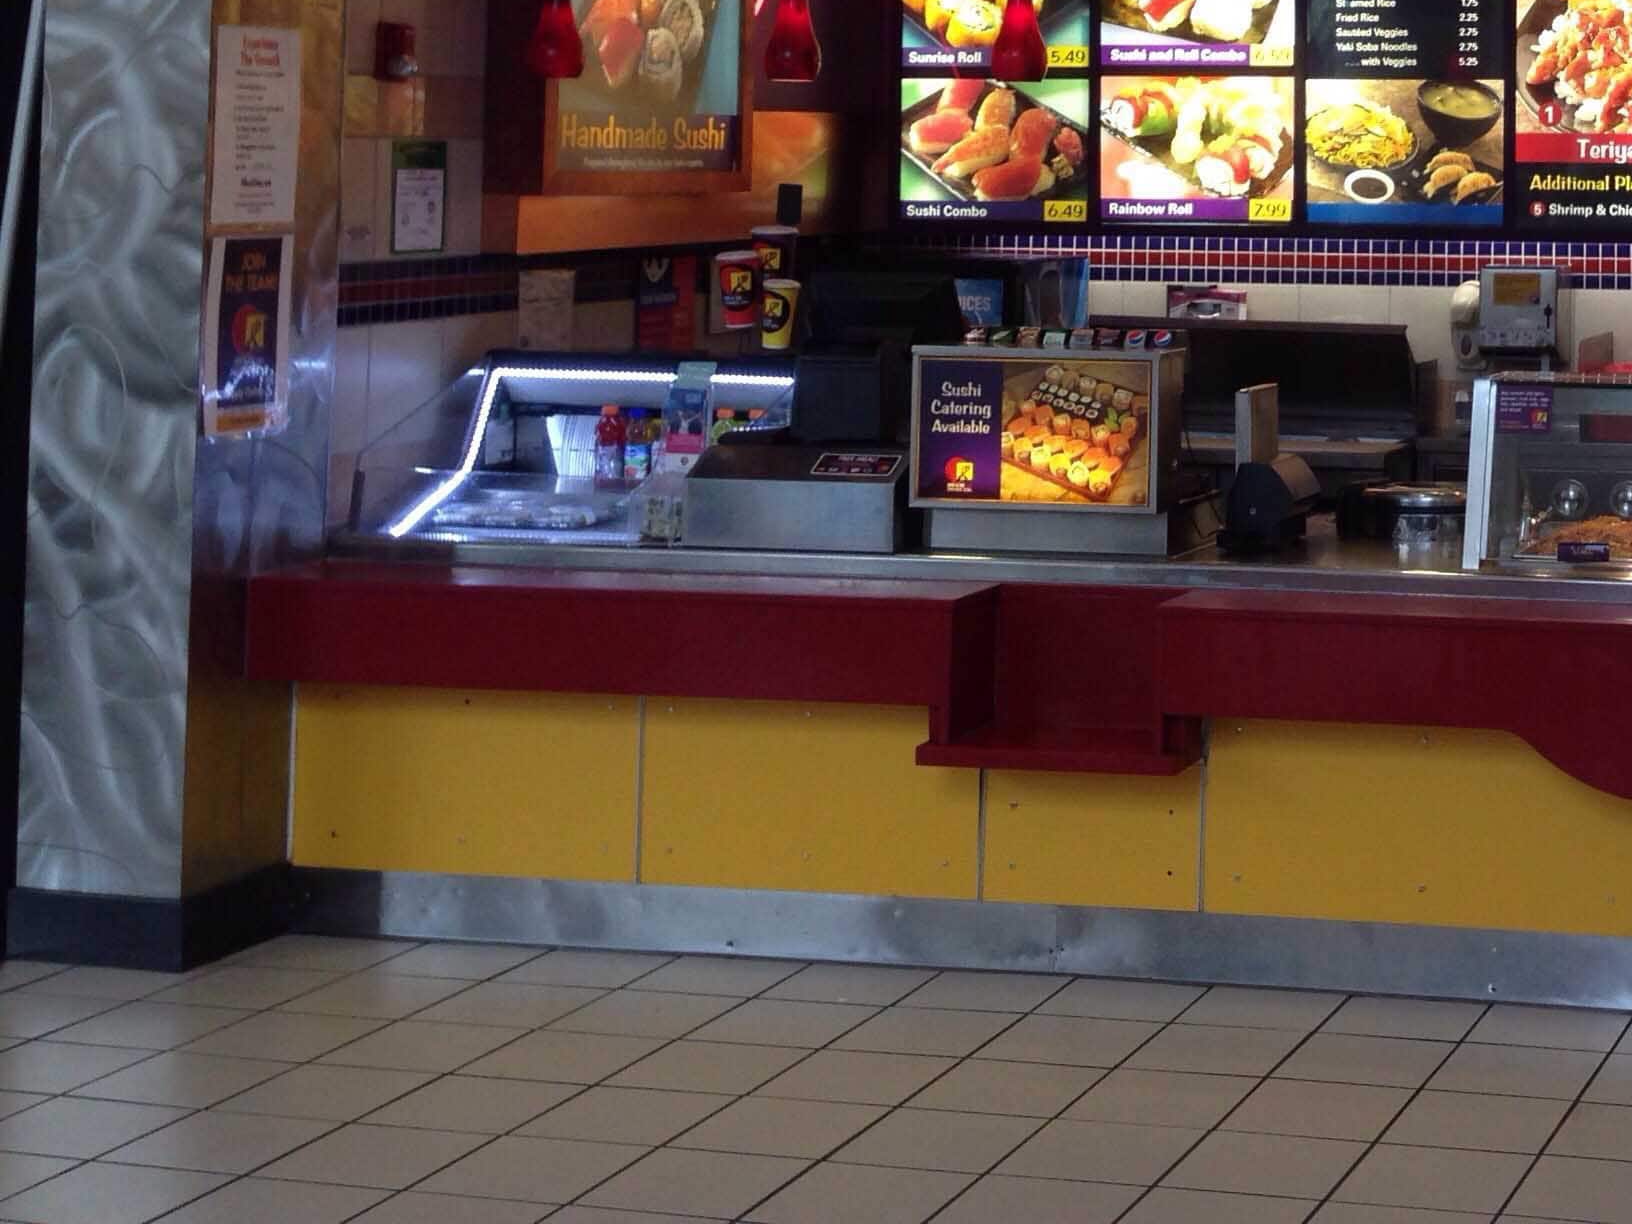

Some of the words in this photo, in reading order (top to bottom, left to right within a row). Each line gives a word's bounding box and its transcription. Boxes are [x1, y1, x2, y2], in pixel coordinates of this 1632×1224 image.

[1336, 13, 1358, 23] Fried
[1360, 13, 1379, 22] Rice
[1374, 28, 1408, 38] Veggies
[1356, 42, 1379, 52] Soba
[1381, 43, 1418, 52] Noodles
[908, 51, 955, 64] Sunrise
[957, 51, 982, 63] Roll
[1051, 50, 1086, 63] 5.49
[1110, 48, 1146, 62] Sushi
[1148, 48, 1173, 61] and
[1200, 48, 1247, 62] Combo
[1383, 57, 1417, 68] Veggies
[1544, 106, 1554, 123] 1
[560, 114, 668, 150] Handmade
[672, 117, 727, 150] Sushi
[1529, 174, 1610, 192] Additional
[906, 204, 942, 218] Sushi
[943, 205, 988, 218] Combo
[1047, 204, 1084, 218] 6.49
[1108, 202, 1165, 216] Rainbow
[1168, 202, 1193, 215] Roll
[1548, 203, 1593, 218] Shrimp
[1596, 204, 1606, 216] &
[941, 381, 982, 397] Sushi
[930, 399, 992, 419] Catering
[931, 419, 991, 434] Available
